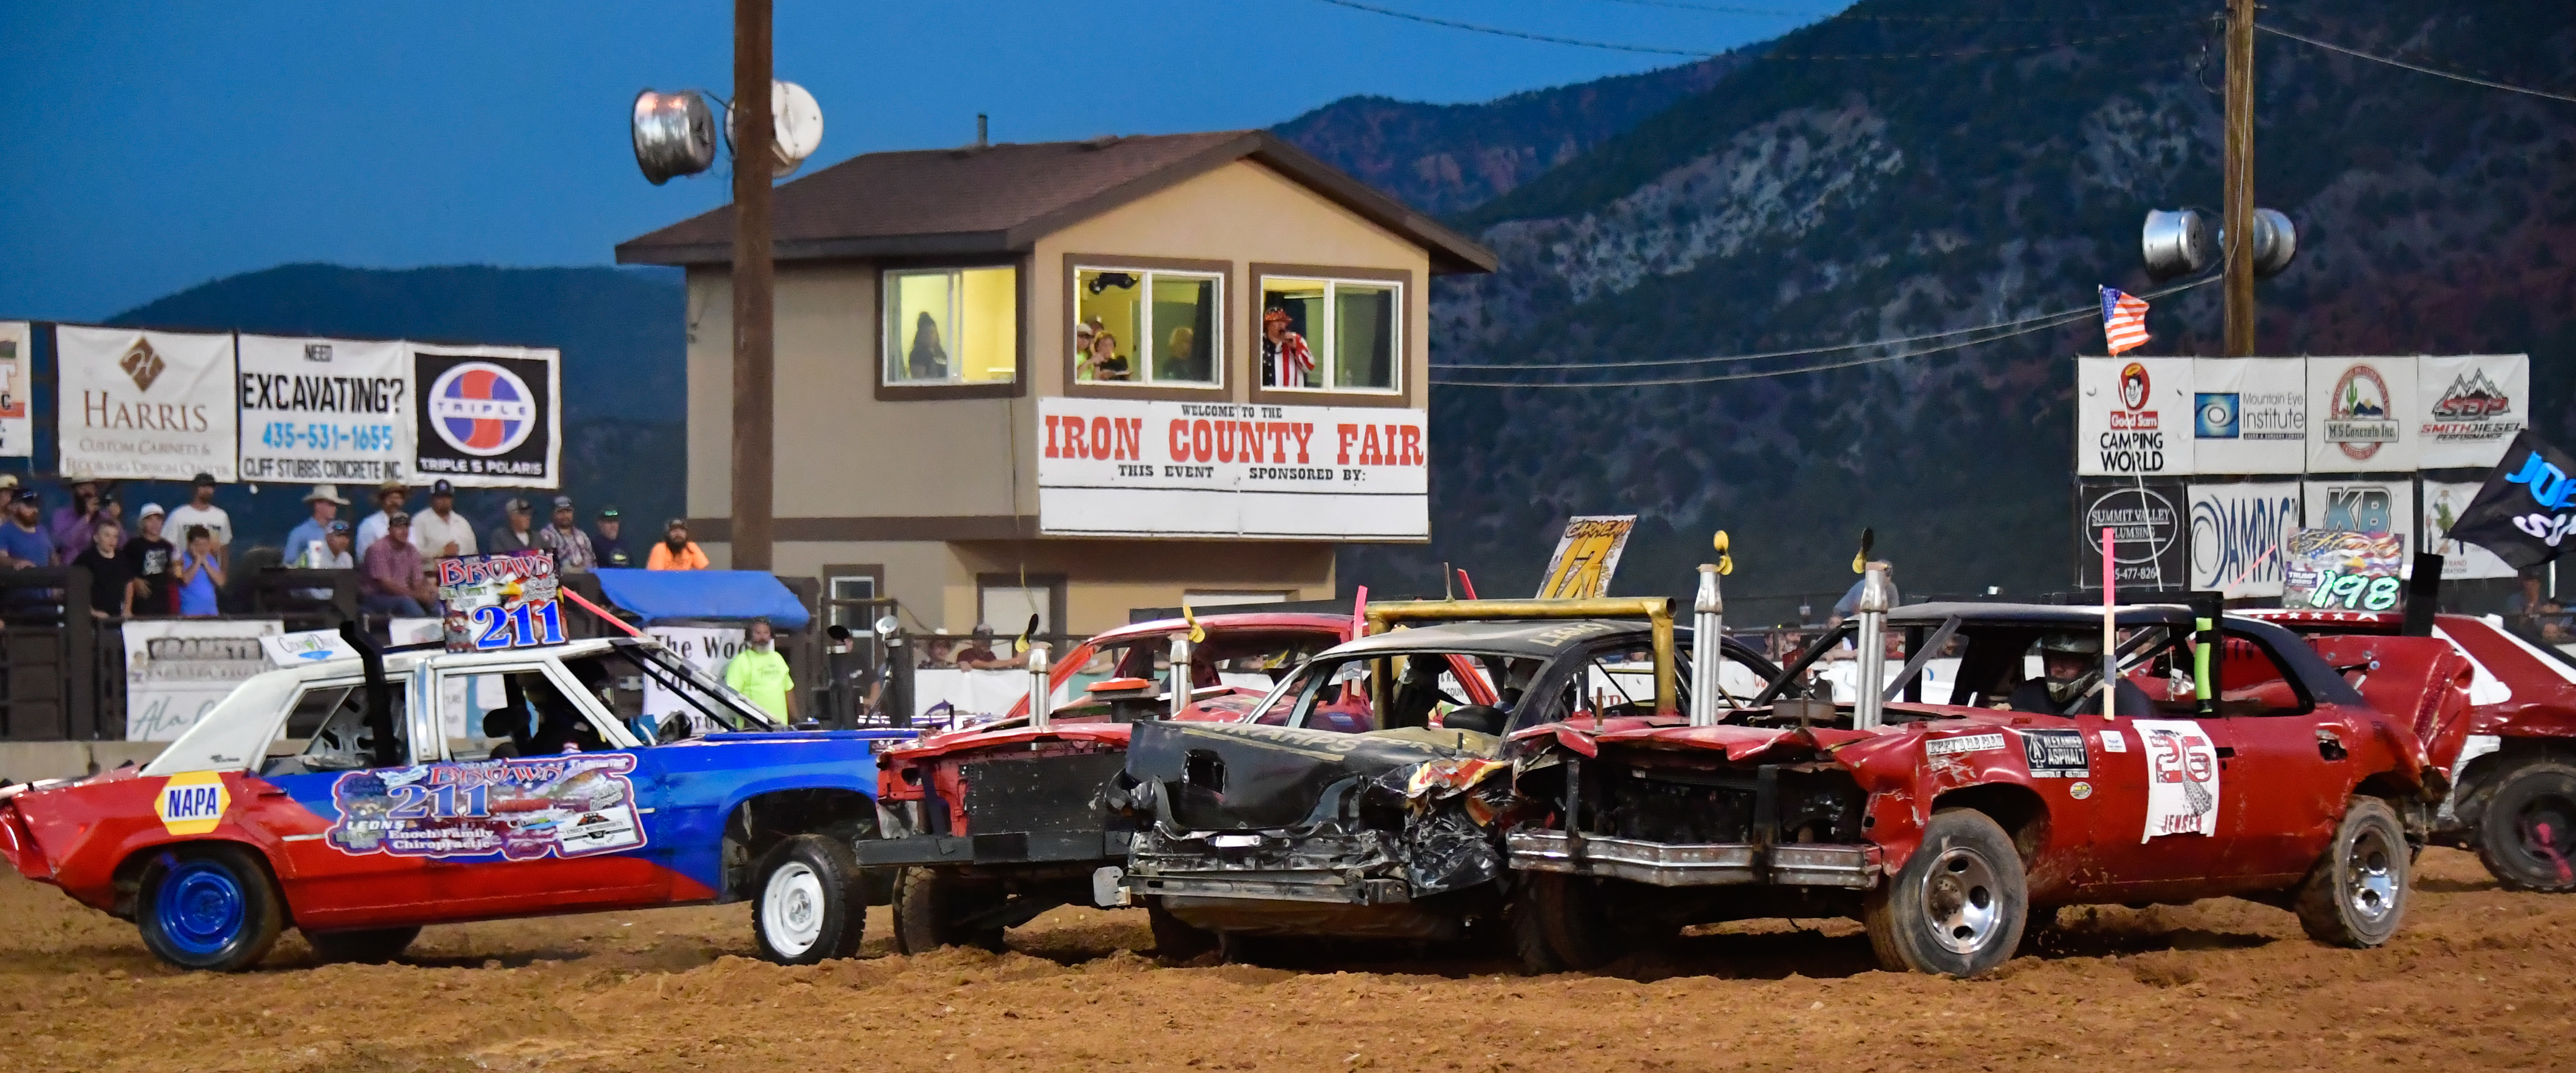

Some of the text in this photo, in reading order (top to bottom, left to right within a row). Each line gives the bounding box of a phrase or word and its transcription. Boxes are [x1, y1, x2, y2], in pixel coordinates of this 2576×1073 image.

[243, 373, 404, 414] EXCAVATING?
[2243, 392, 2303, 407] Mountain Eye
[84, 389, 208, 433] HARRIS
[438, 401, 527, 416] TRIPLE
[1181, 404, 1283, 419] WELCOME TO THE
[2243, 408, 2304, 429] Institute
[2435, 398, 2508, 421] SDP
[2137, 413, 2157, 427] Sam
[263, 422, 393, 451] 435-531-1655
[1045, 415, 1424, 467] IRON COUNTY FAIR
[2100, 432, 2163, 450] CAMPING
[244, 458, 273, 476] CLIFF
[278, 458, 321, 477] STUBBS
[323, 460, 380, 479] CONCRETE
[419, 457, 469, 473] TRIPLE
[487, 459, 542, 475] POLARIS
[2100, 451, 2164, 472] WORLD
[1118, 464, 1367, 482] THIS EVENT SPONSORED BY:
[2091, 508, 2170, 523] SUMMIT VALLEY
[2324, 486, 2391, 532] KB
[2113, 526, 2155, 539] LUMBING
[438, 553, 554, 587] BROWN
[2115, 566, 2161, 580] 5-477-826
[2311, 569, 2400, 611] 198
[472, 599, 565, 650] 211
[1446, 687, 1465, 697] COUN
[2047, 748, 2085, 765] ASPHALT
[2148, 735, 2212, 783] 26
[168, 786, 217, 818] NAPA
[385, 784, 491, 819] 211
[388, 828, 495, 842] Enoch Family
[392, 839, 491, 851] Chiropractic
